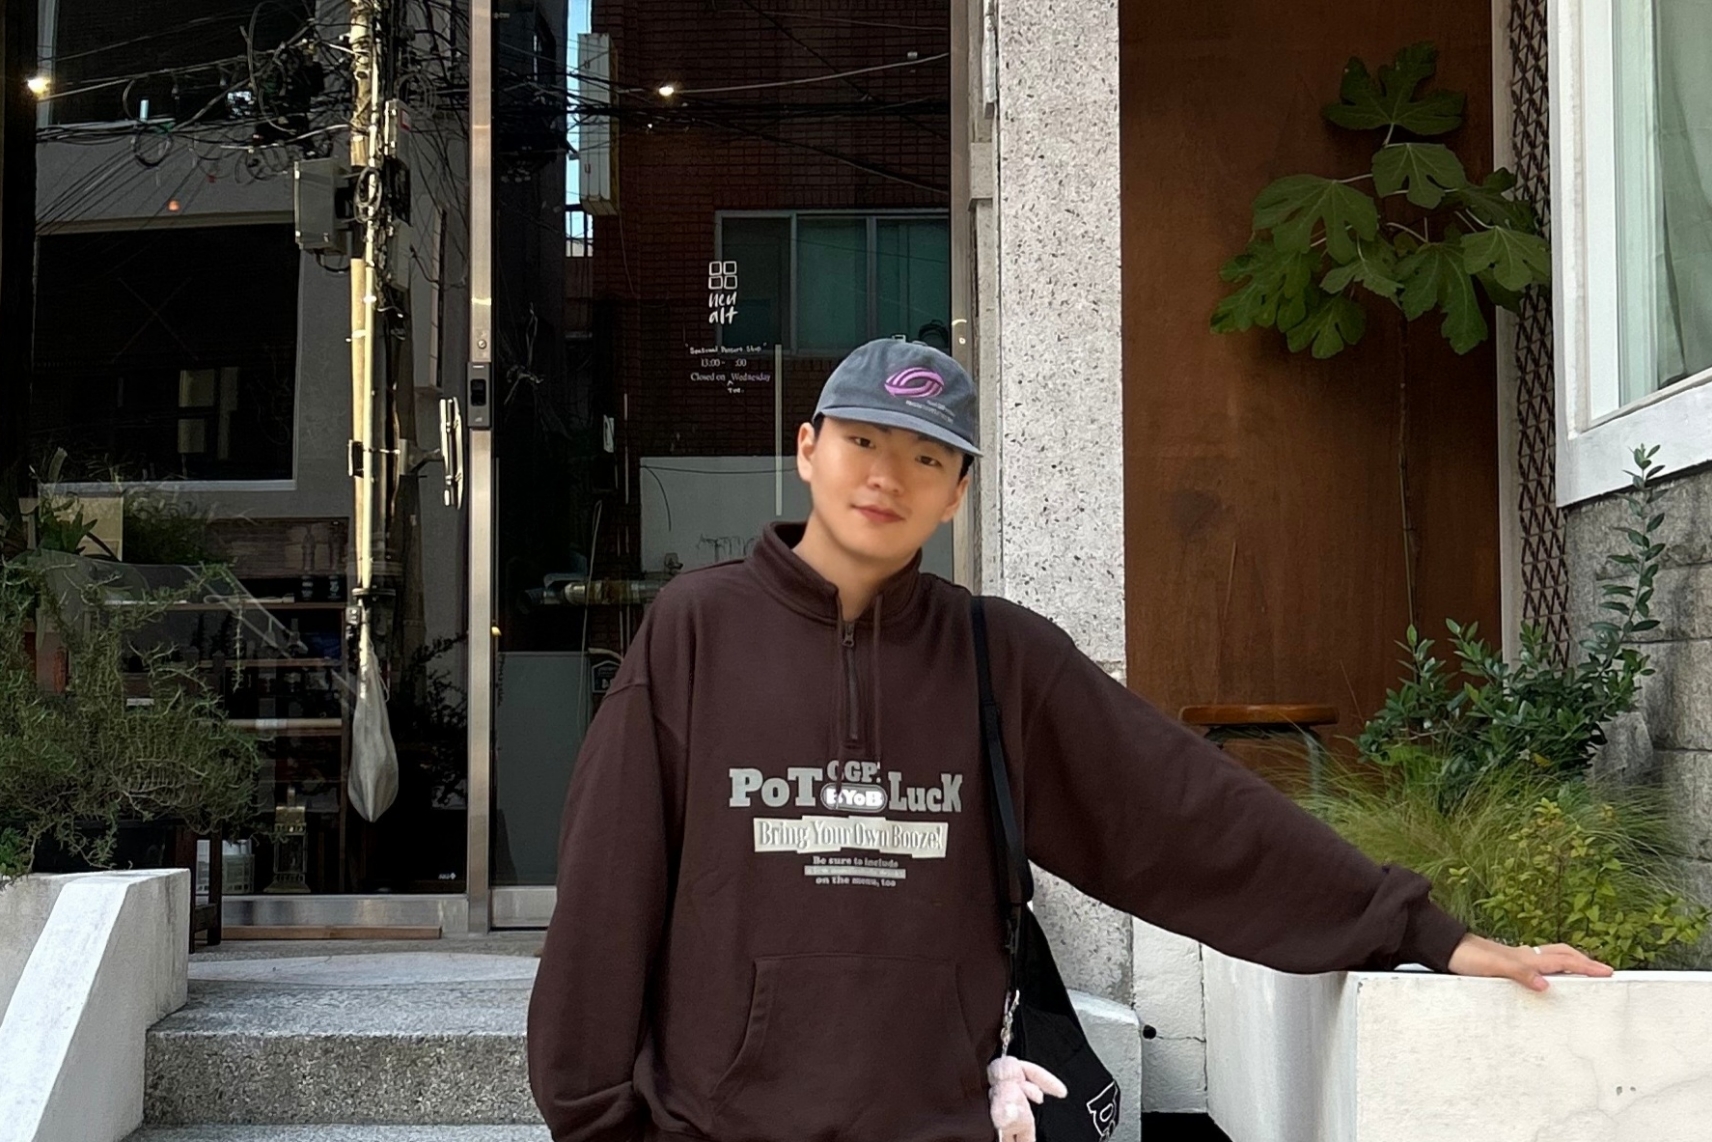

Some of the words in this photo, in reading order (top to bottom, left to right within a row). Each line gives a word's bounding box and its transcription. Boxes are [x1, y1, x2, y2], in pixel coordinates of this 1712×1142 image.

[708, 306, 738, 325] alt
[690, 372, 715, 381] Closed
[731, 372, 771, 382] Wednesday
[759, 821, 810, 848] Bring
[811, 819, 853, 847] Your
[854, 821, 890, 849] Own
[813, 855, 827, 865] Be
[828, 857, 852, 865] sure
[854, 857, 864, 866] to
[864, 857, 899, 868] include
[815, 877, 830, 885] on
[832, 876, 850, 885] the
[851, 877, 880, 887] menu,
[881, 878, 897, 887] too
